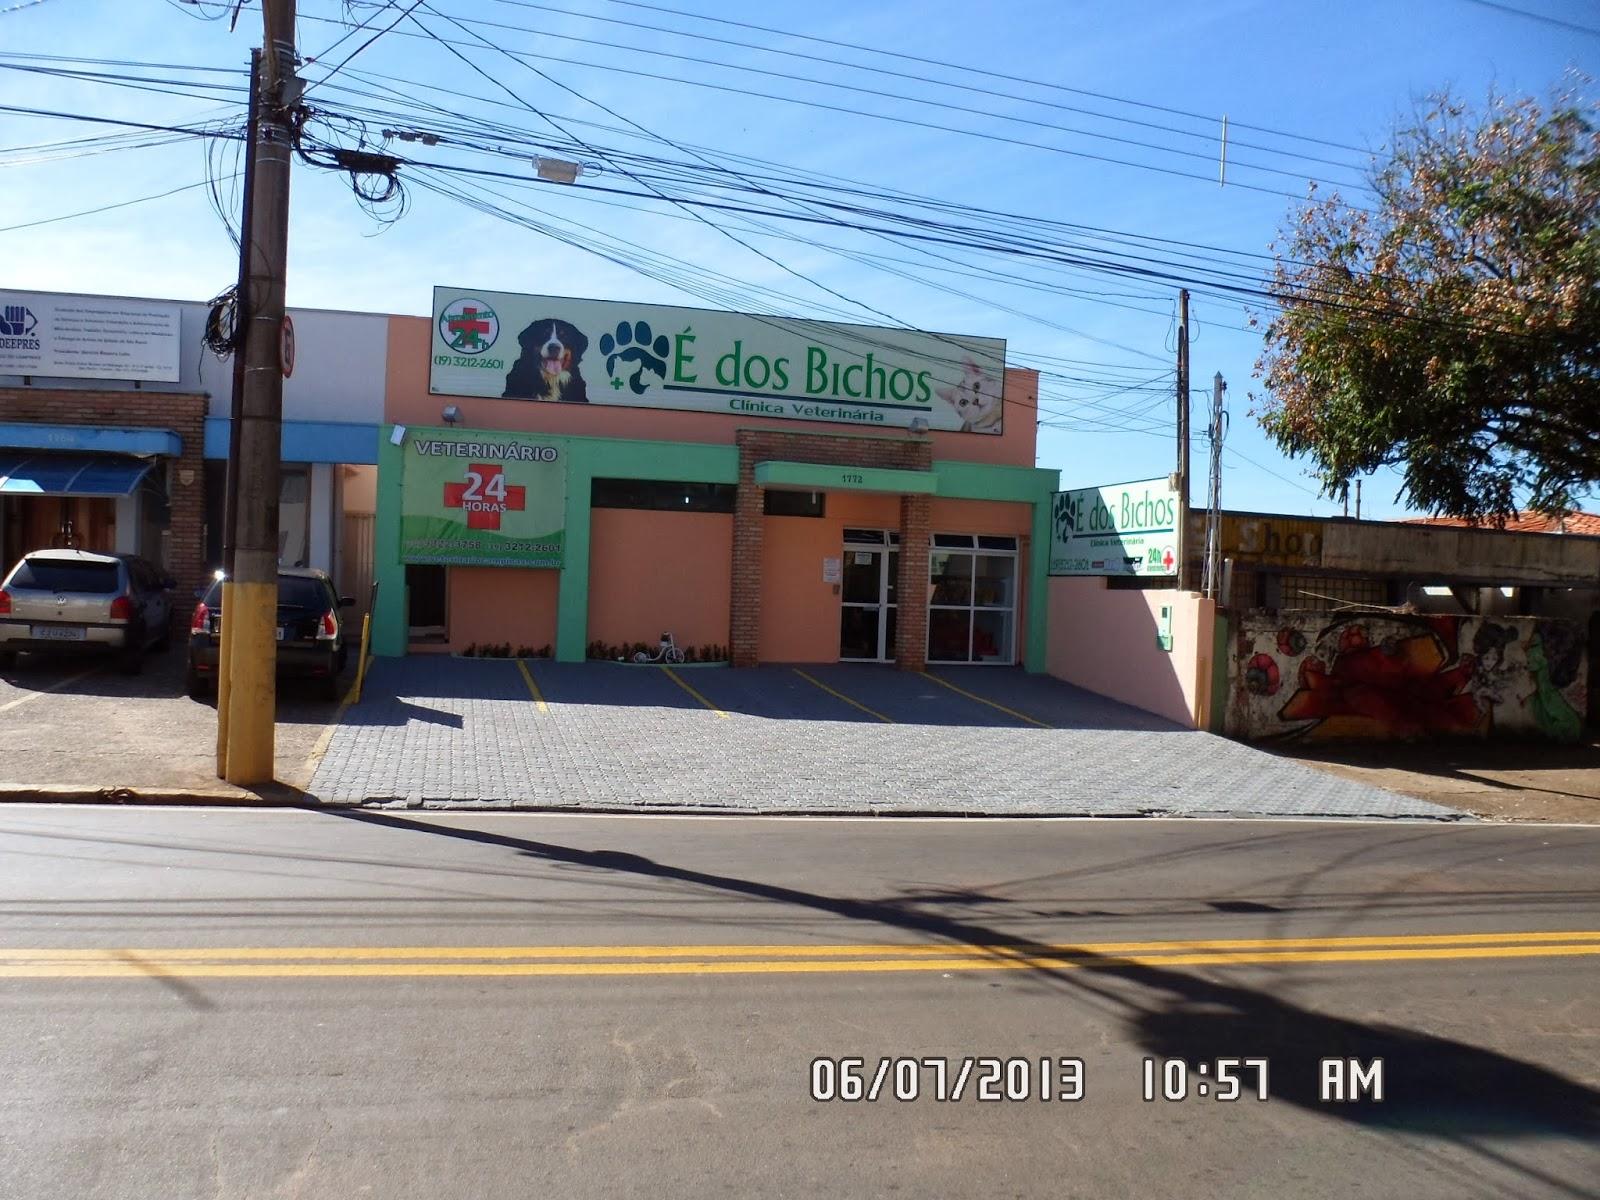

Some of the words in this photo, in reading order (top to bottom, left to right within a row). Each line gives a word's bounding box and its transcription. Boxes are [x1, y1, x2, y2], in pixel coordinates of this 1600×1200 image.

[673, 326, 698, 383] É
[715, 340, 789, 391] dos
[806, 347, 932, 402] Bichos
[729, 399, 784, 414] Clínica
[792, 404, 885, 421] Veterinária
[414, 440, 558, 462] VETERINÁRIO
[462, 471, 507, 502] 24
[842, 474, 863, 484] 1772
[462, 501, 507, 513] HORAS
[1075, 494, 1085, 532] É
[1089, 495, 1115, 532] dos
[1121, 490, 1174, 529] Bichos
